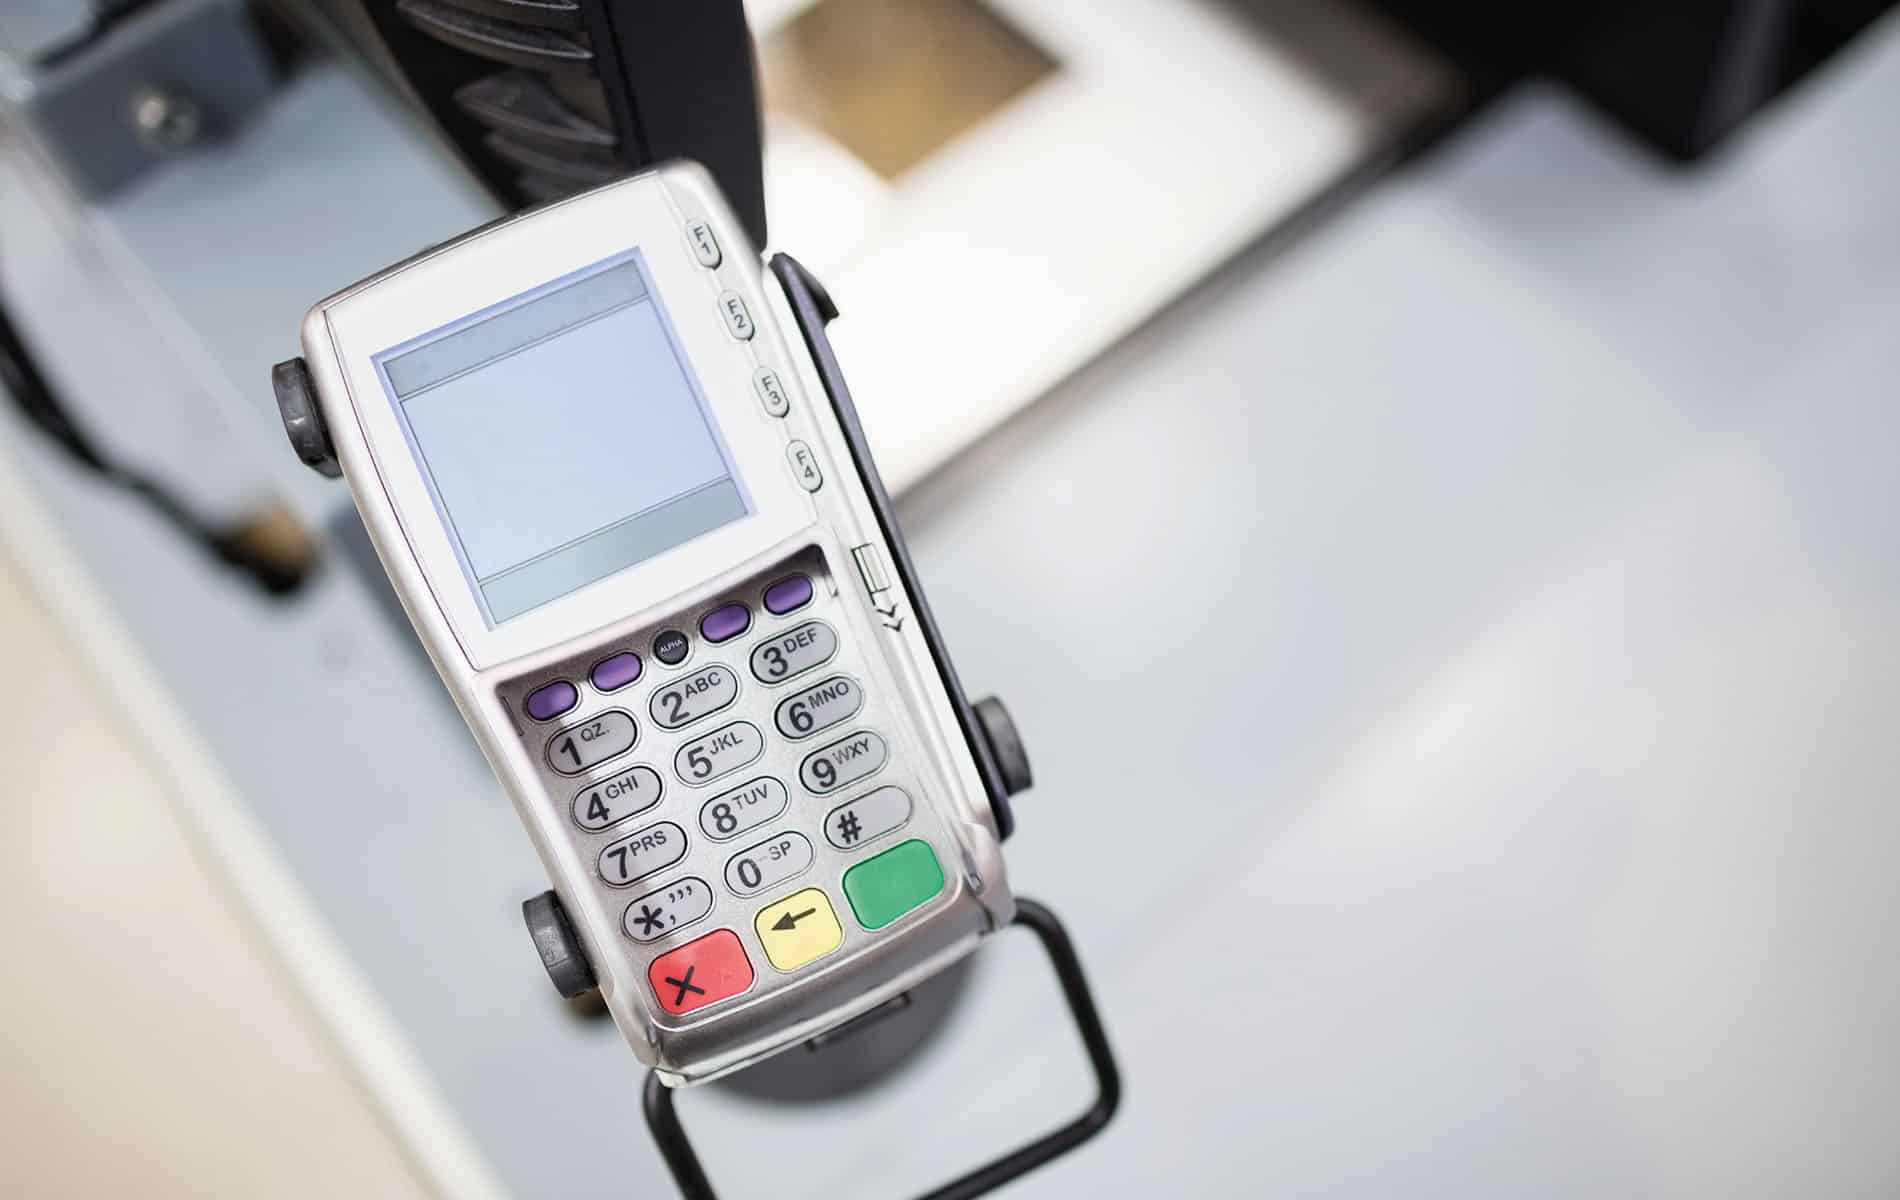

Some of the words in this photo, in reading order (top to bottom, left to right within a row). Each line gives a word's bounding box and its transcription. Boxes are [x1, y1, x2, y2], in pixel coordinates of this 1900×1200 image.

[660, 638, 683, 653] ALPHA
[783, 628, 818, 653] DEF
[685, 671, 722, 699] ABC
[808, 681, 850, 709] MNO
[710, 732, 745, 755] JKL
[832, 738, 870, 765] WXY
[605, 775, 639, 799] GHI
[731, 784, 768, 810] TUV
[629, 831, 667, 857] PRS
